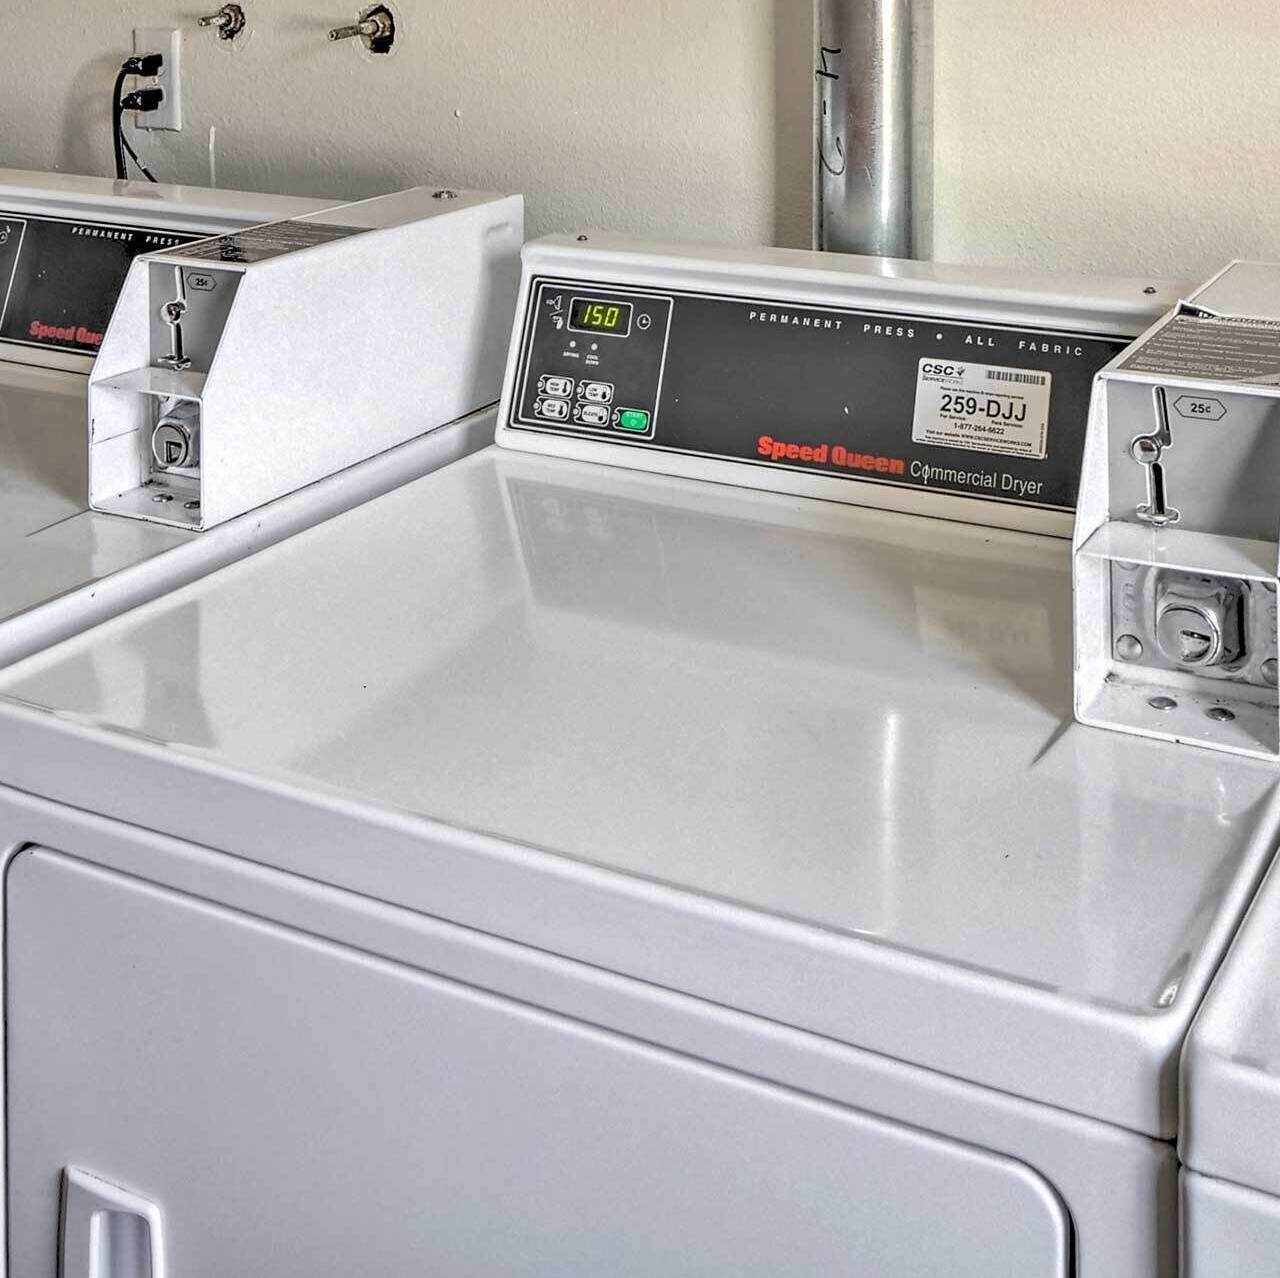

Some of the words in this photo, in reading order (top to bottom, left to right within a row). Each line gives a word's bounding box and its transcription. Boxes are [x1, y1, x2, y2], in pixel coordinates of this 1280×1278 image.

[72, 227, 134, 241] PERMANENT
[583, 304, 619, 327] 150
[30, 321, 75, 340] Speed
[75, 327, 104, 344] Que
[749, 310, 844, 331] PERMANENT
[863, 323, 917, 338] PRESS
[964, 334, 996, 348] ALL
[1019, 339, 1085, 357] FABRIC
[922, 363, 954, 376] CSC
[940, 394, 1027, 421] 259-DJJ
[756, 435, 829, 465] Speed
[830, 448, 905, 474] Queen
[909, 462, 997, 488] Commercial
[1001, 472, 1043, 499] Dryer
